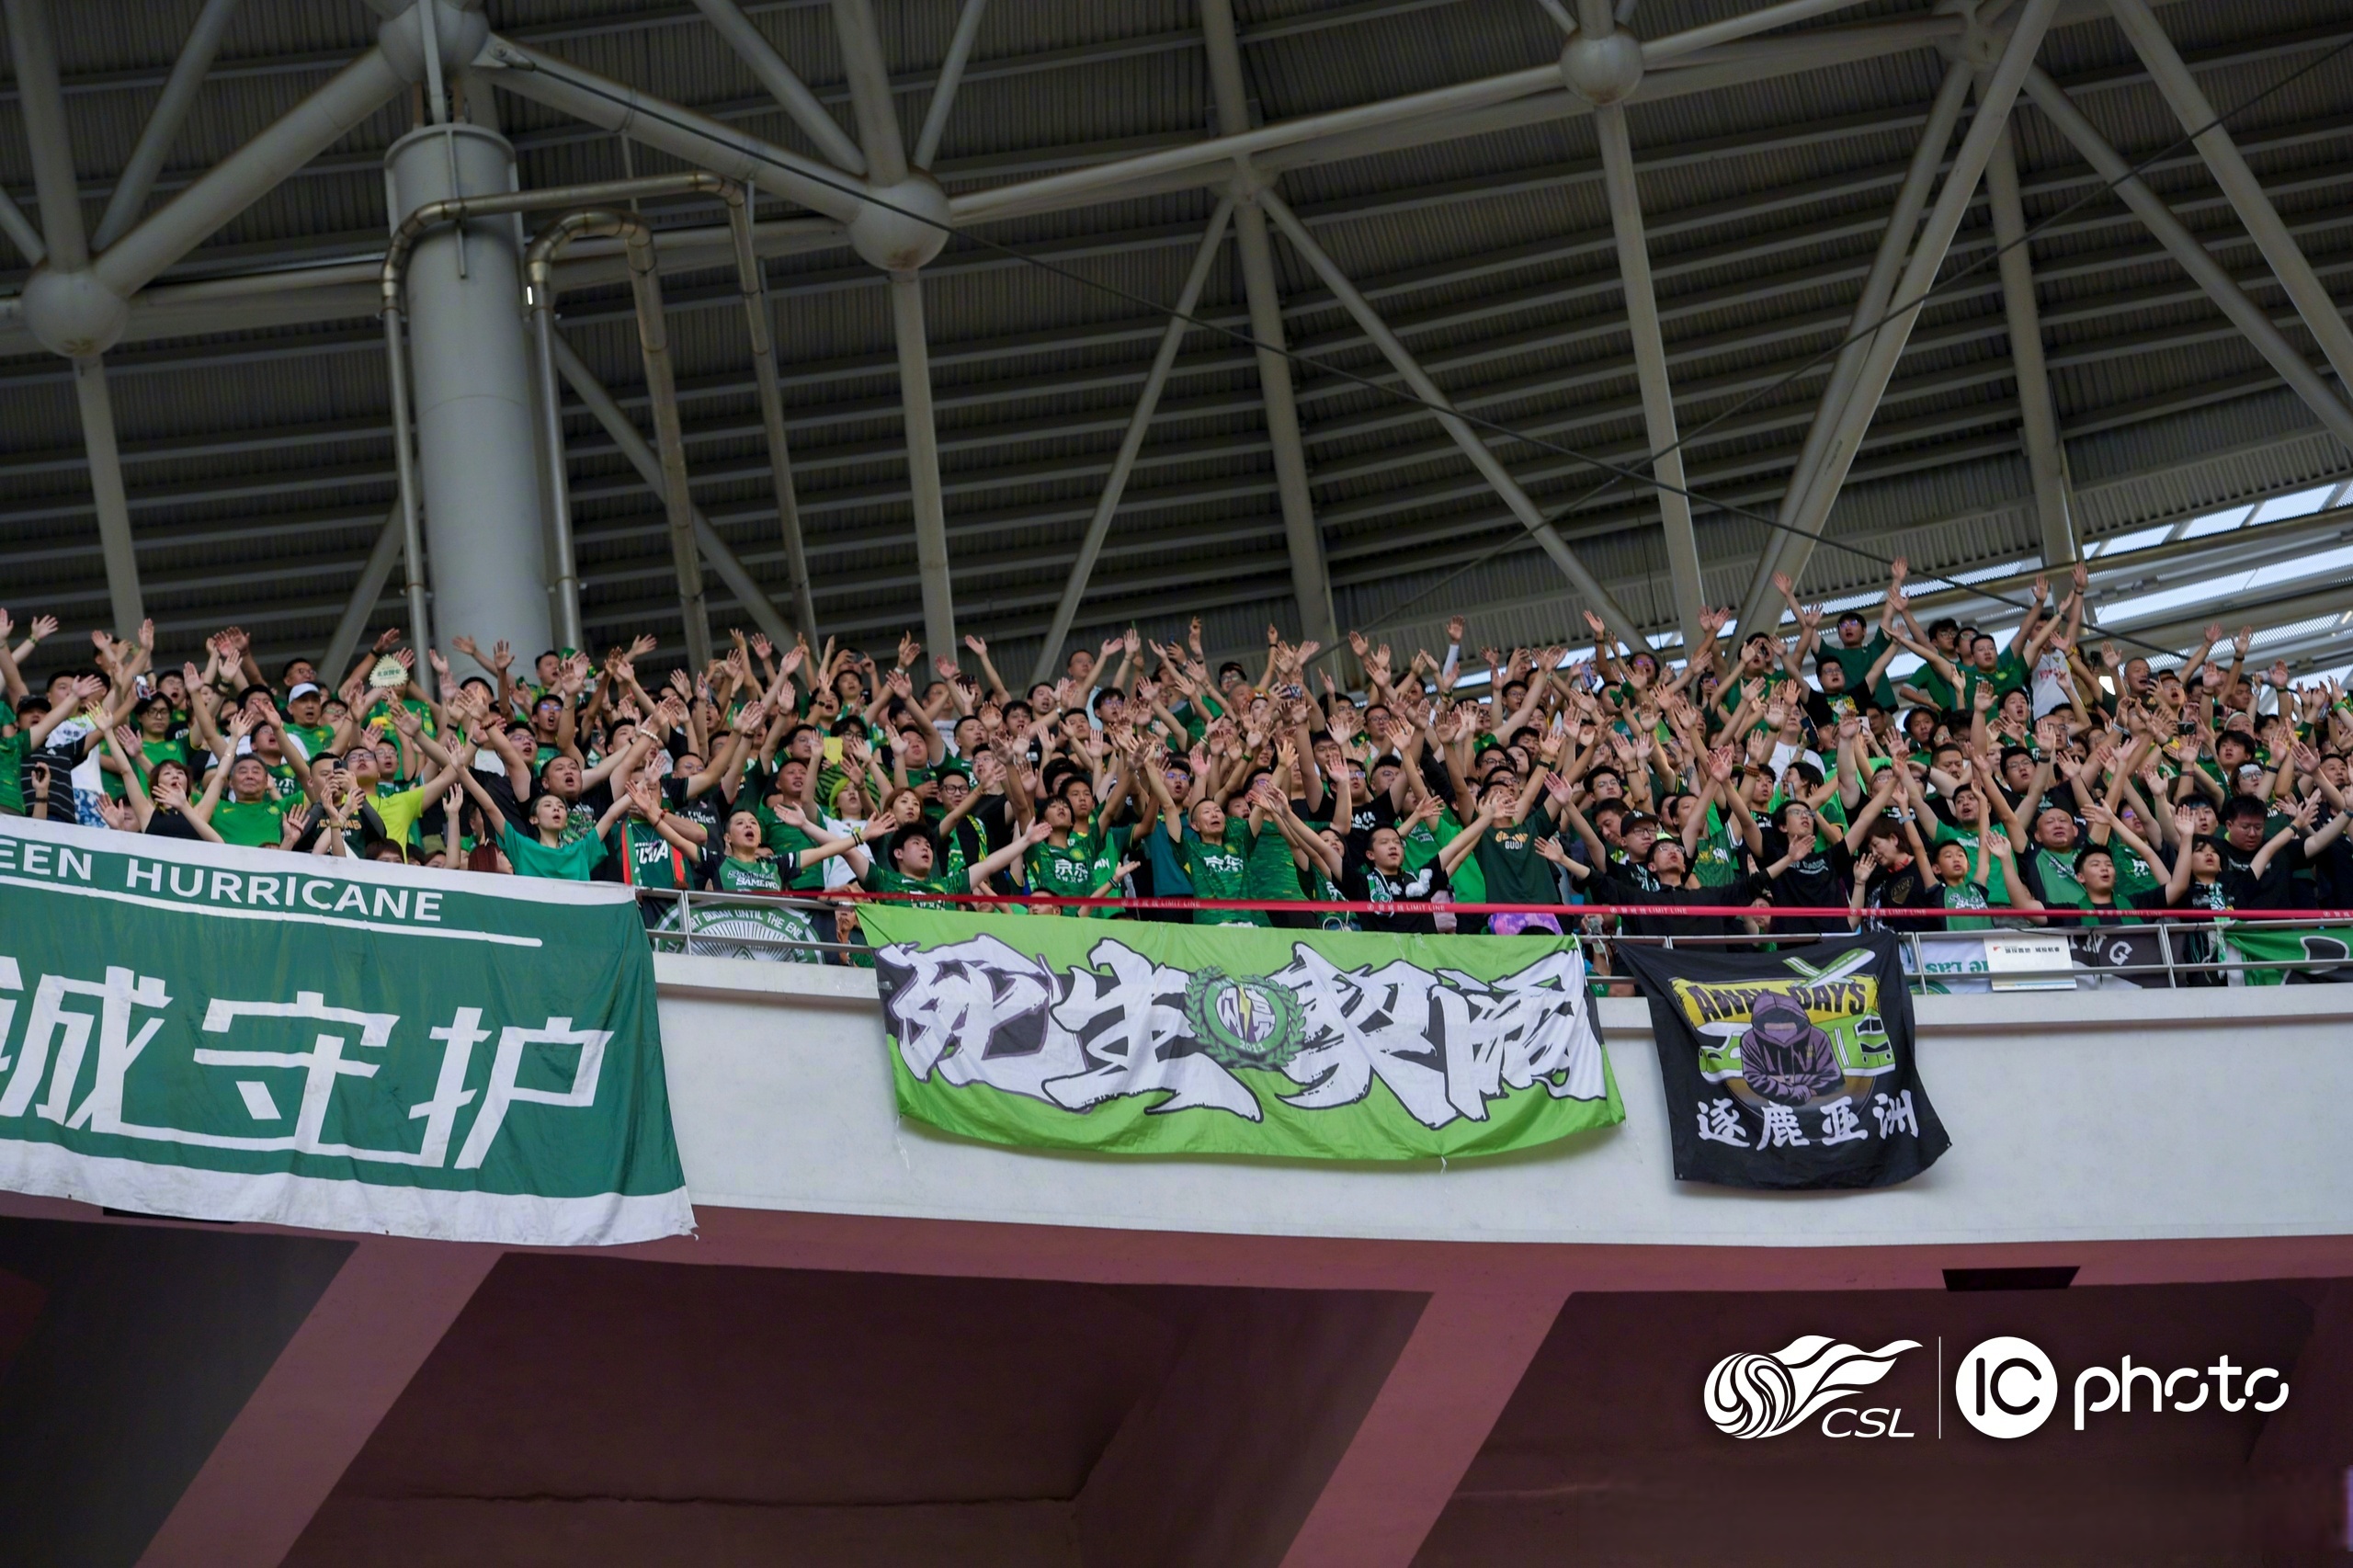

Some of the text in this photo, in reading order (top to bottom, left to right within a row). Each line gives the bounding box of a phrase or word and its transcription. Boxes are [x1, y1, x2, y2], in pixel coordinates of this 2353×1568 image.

[126, 856, 443, 922] HURRICANE
[734, 909, 763, 921] UNTIL
[767, 912, 784, 928] THE
[1648, 906, 1667, 915] LIMIT
[1670, 906, 1688, 915] LINE
[1239, 1040, 1267, 1053] 2011
